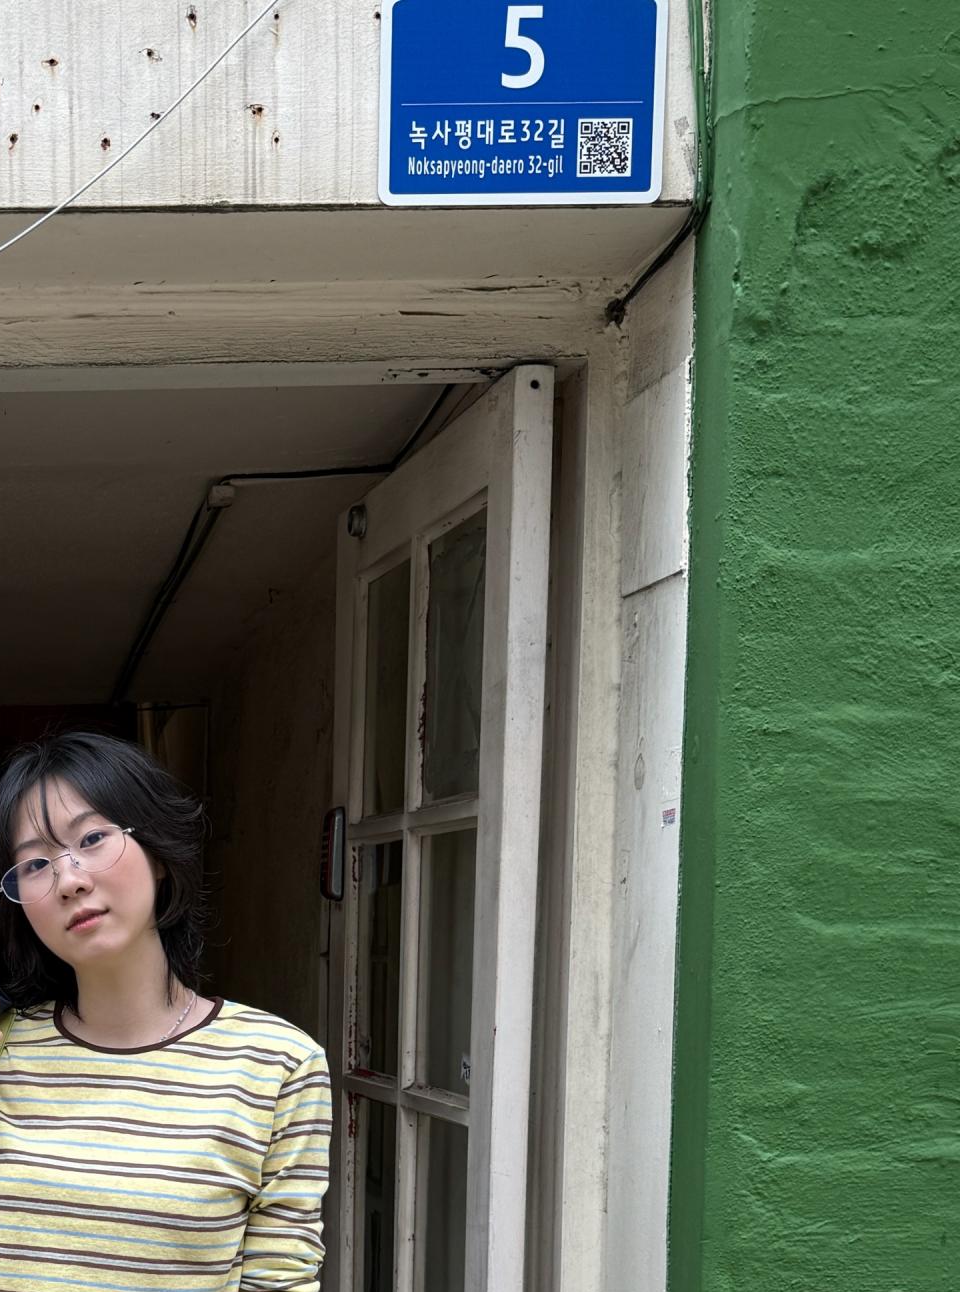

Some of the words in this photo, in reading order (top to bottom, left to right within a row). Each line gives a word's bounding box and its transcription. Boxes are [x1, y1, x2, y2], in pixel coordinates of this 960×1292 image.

[501, 5, 545, 89] 5
[409, 118, 565, 150] 녹사평대로32길
[408, 156, 524, 179] Noksapyeong-daero
[528, 154, 564, 178] 32-gil
